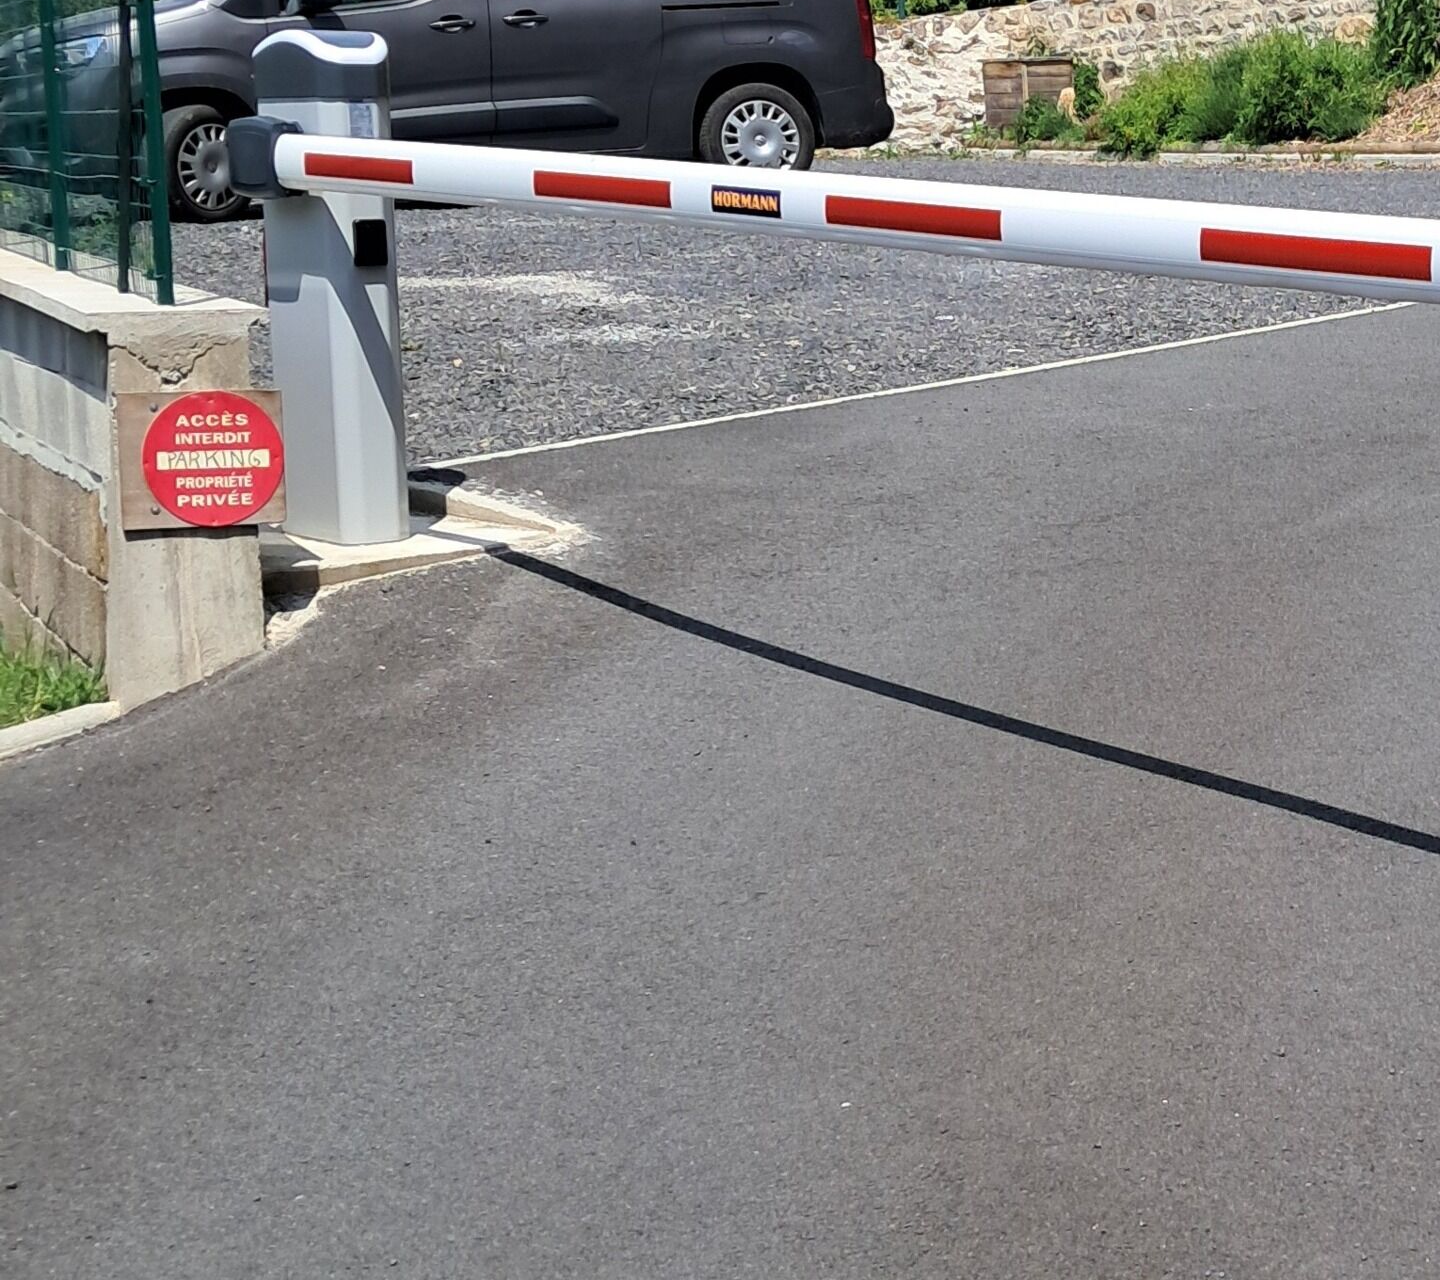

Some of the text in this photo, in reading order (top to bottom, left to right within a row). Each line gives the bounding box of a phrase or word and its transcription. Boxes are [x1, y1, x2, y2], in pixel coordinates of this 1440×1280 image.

[176, 410, 249, 427] ACCÈS
[175, 432, 251, 445] INTERDIT
[167, 450, 262, 469] PARKING
[176, 472, 253, 489] PROPRIÉTÉ
[177, 490, 254, 507] PRIVÉE
